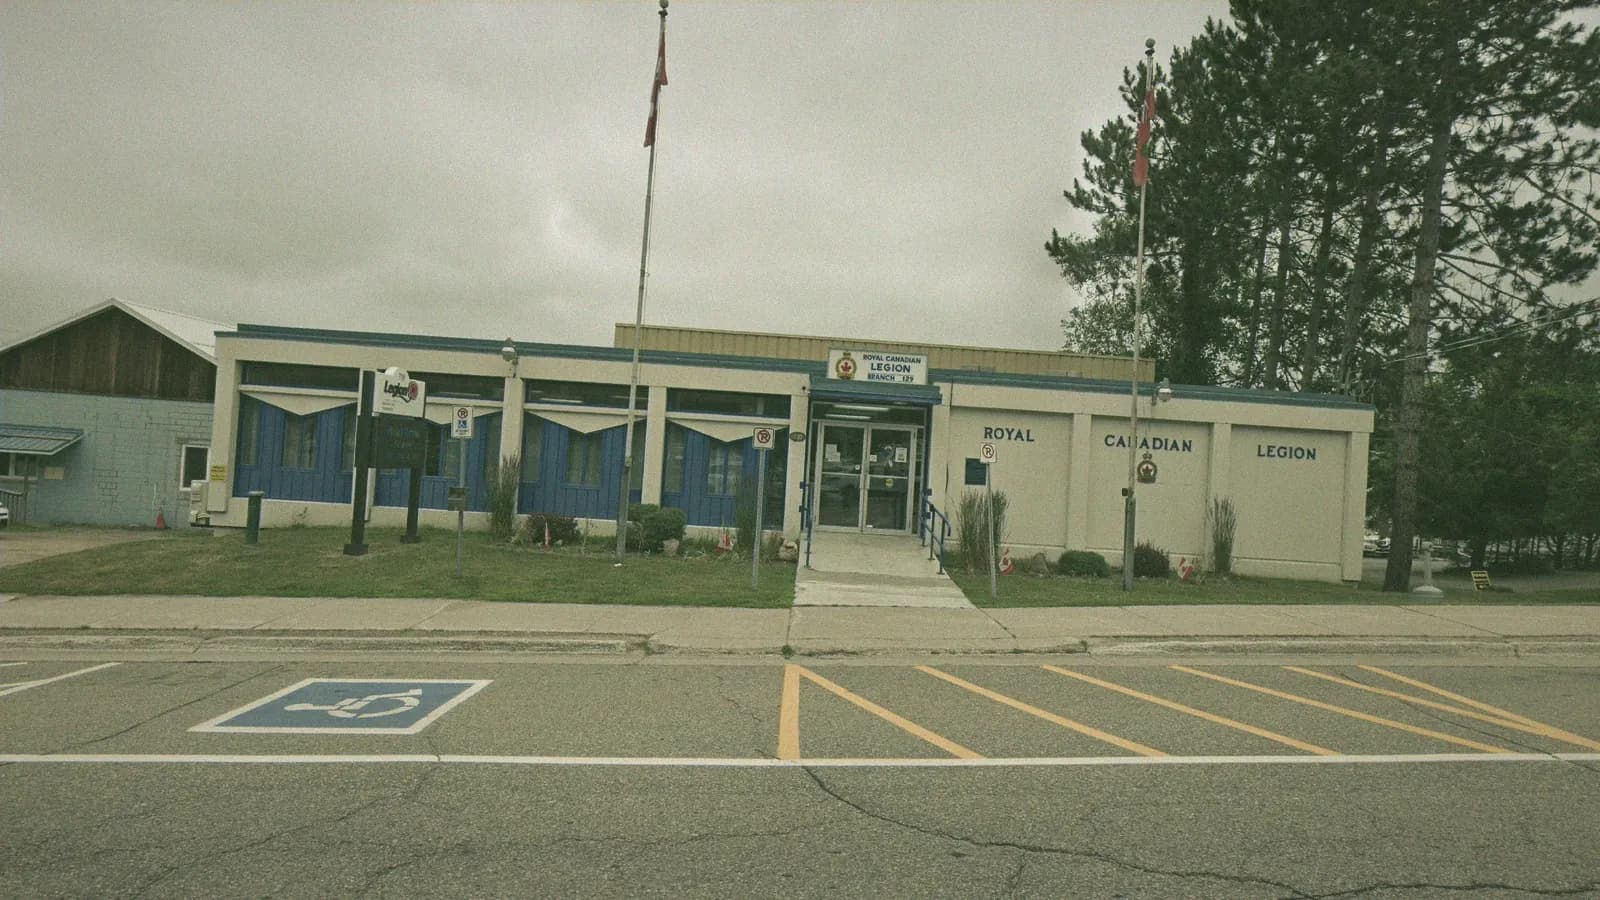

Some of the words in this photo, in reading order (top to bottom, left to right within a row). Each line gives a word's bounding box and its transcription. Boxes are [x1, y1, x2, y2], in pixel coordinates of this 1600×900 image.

[885, 355, 921, 364] CANADIAN
[871, 363, 911, 373] LEGION
[868, 373, 895, 381] BRANCH
[984, 427, 1034, 442] ROYAL
[1257, 445, 1316, 460] LEGION
